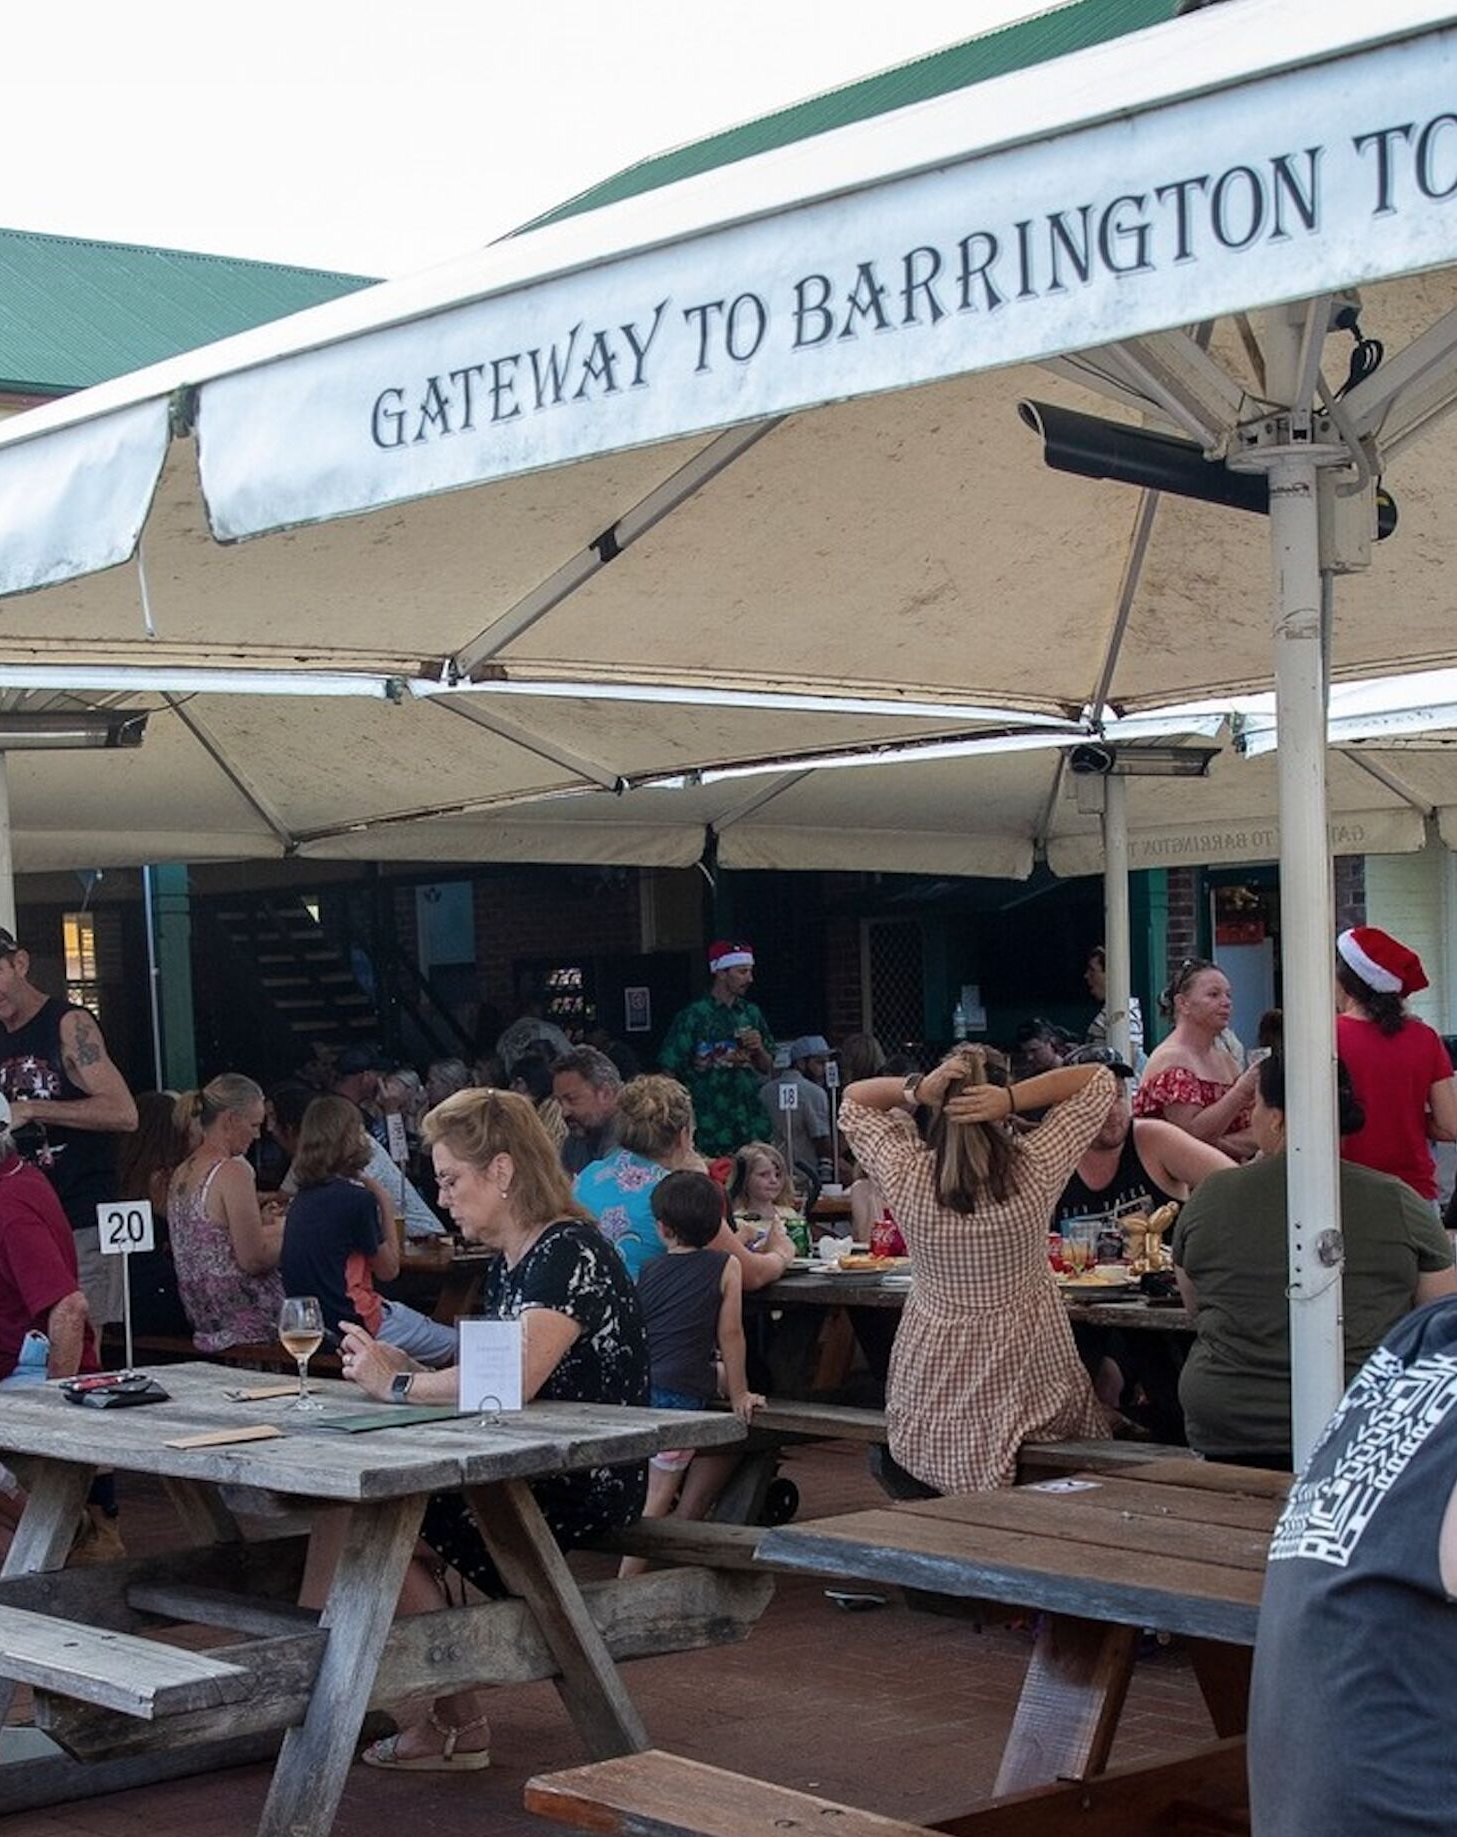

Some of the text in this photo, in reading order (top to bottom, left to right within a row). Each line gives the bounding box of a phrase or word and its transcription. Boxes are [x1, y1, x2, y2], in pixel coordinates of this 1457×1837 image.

[371, 298, 670, 451] GATEWAY
[682, 292, 768, 372] TO
[790, 147, 1325, 353] BARRINGTON
[782, 1088, 795, 1106] 18
[107, 1210, 144, 1244] 20
